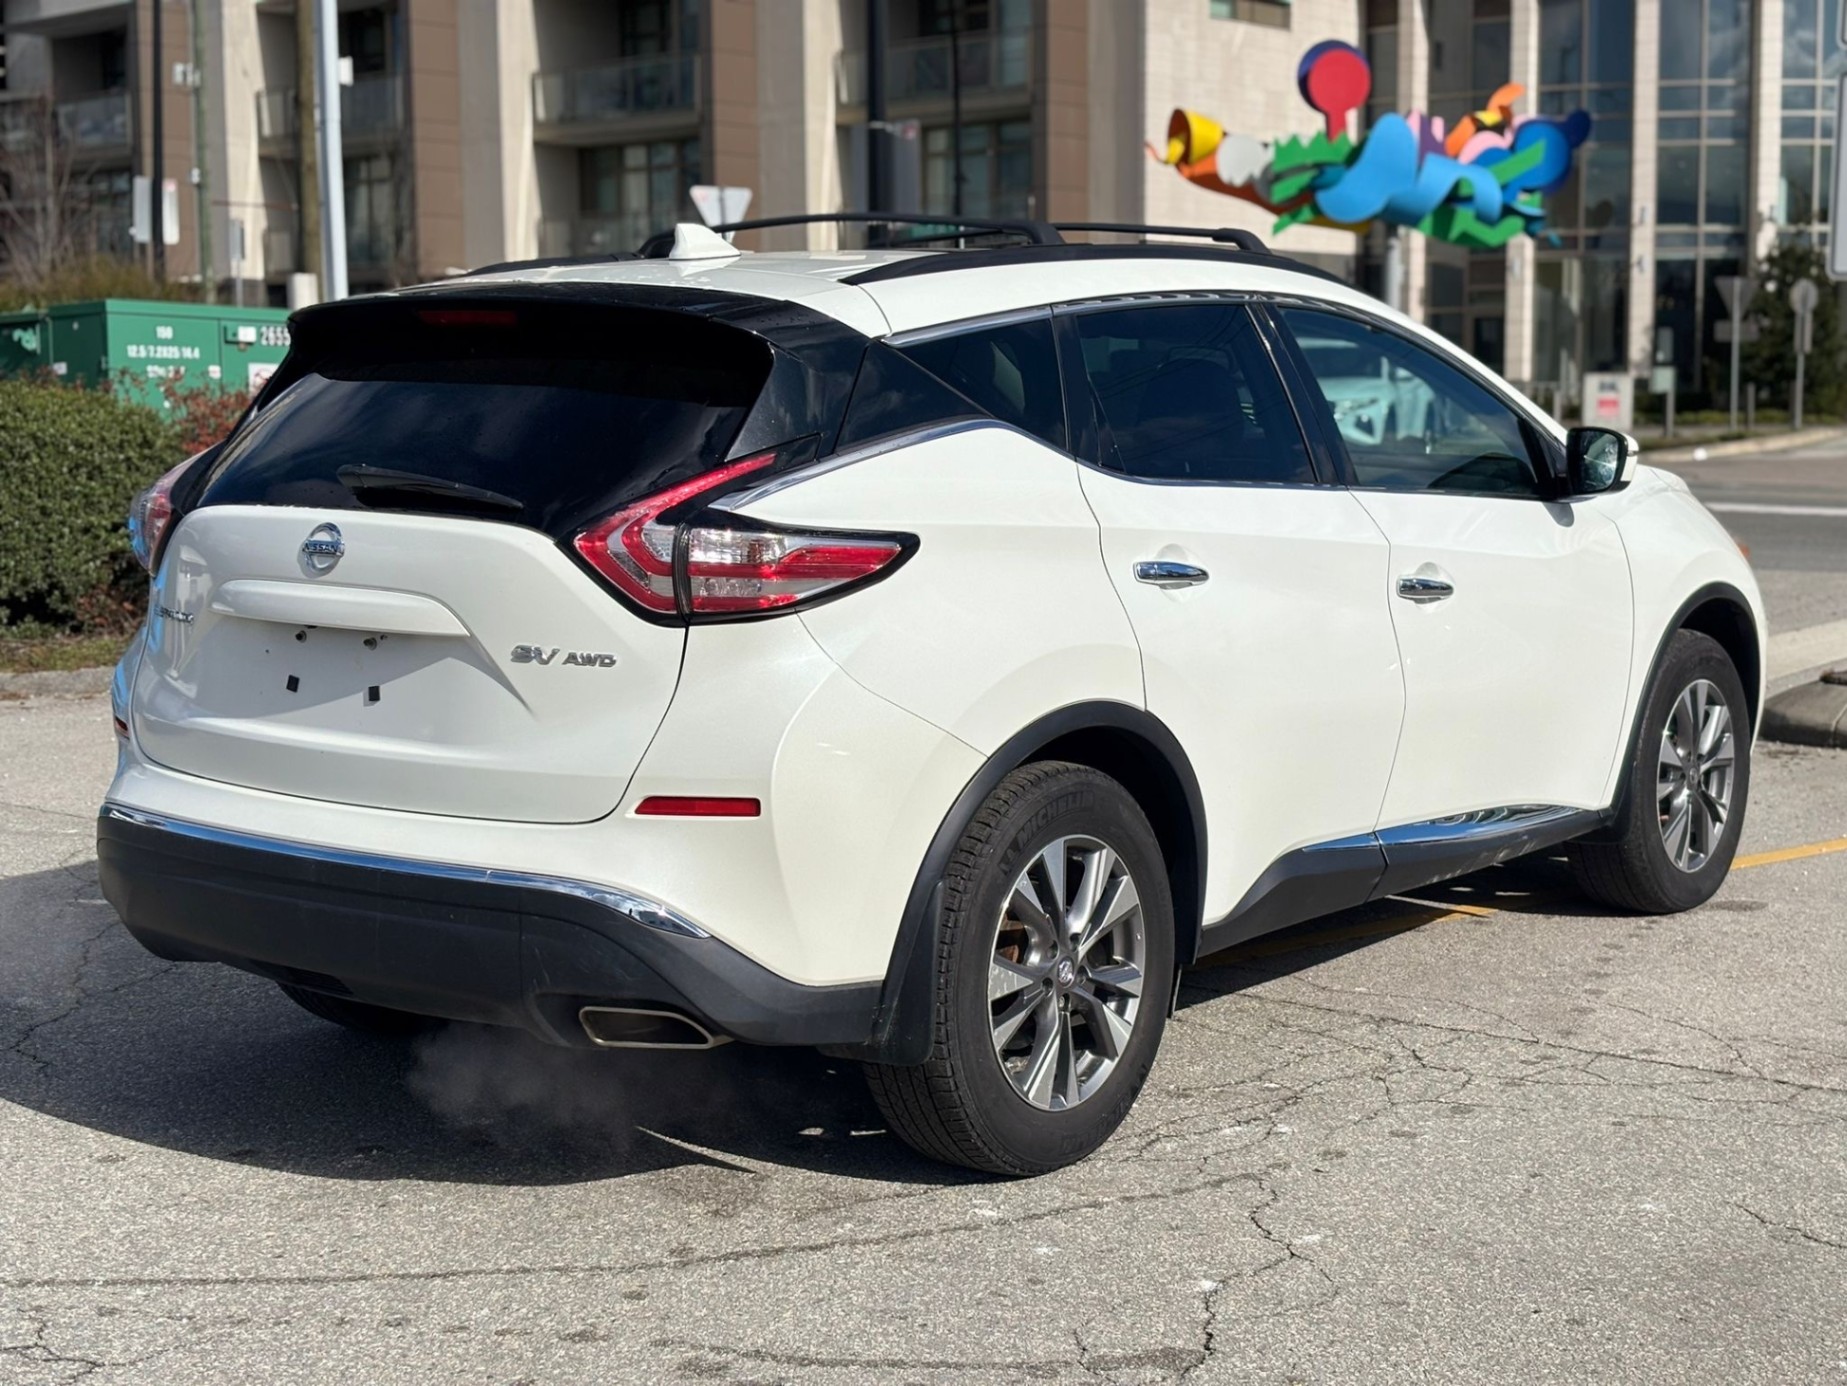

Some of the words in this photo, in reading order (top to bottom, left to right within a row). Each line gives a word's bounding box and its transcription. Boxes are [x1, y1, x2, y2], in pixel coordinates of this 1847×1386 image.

[302, 542, 340, 553] NISSAN
[510, 644, 560, 665] SV
[562, 652, 617, 667] AWD
